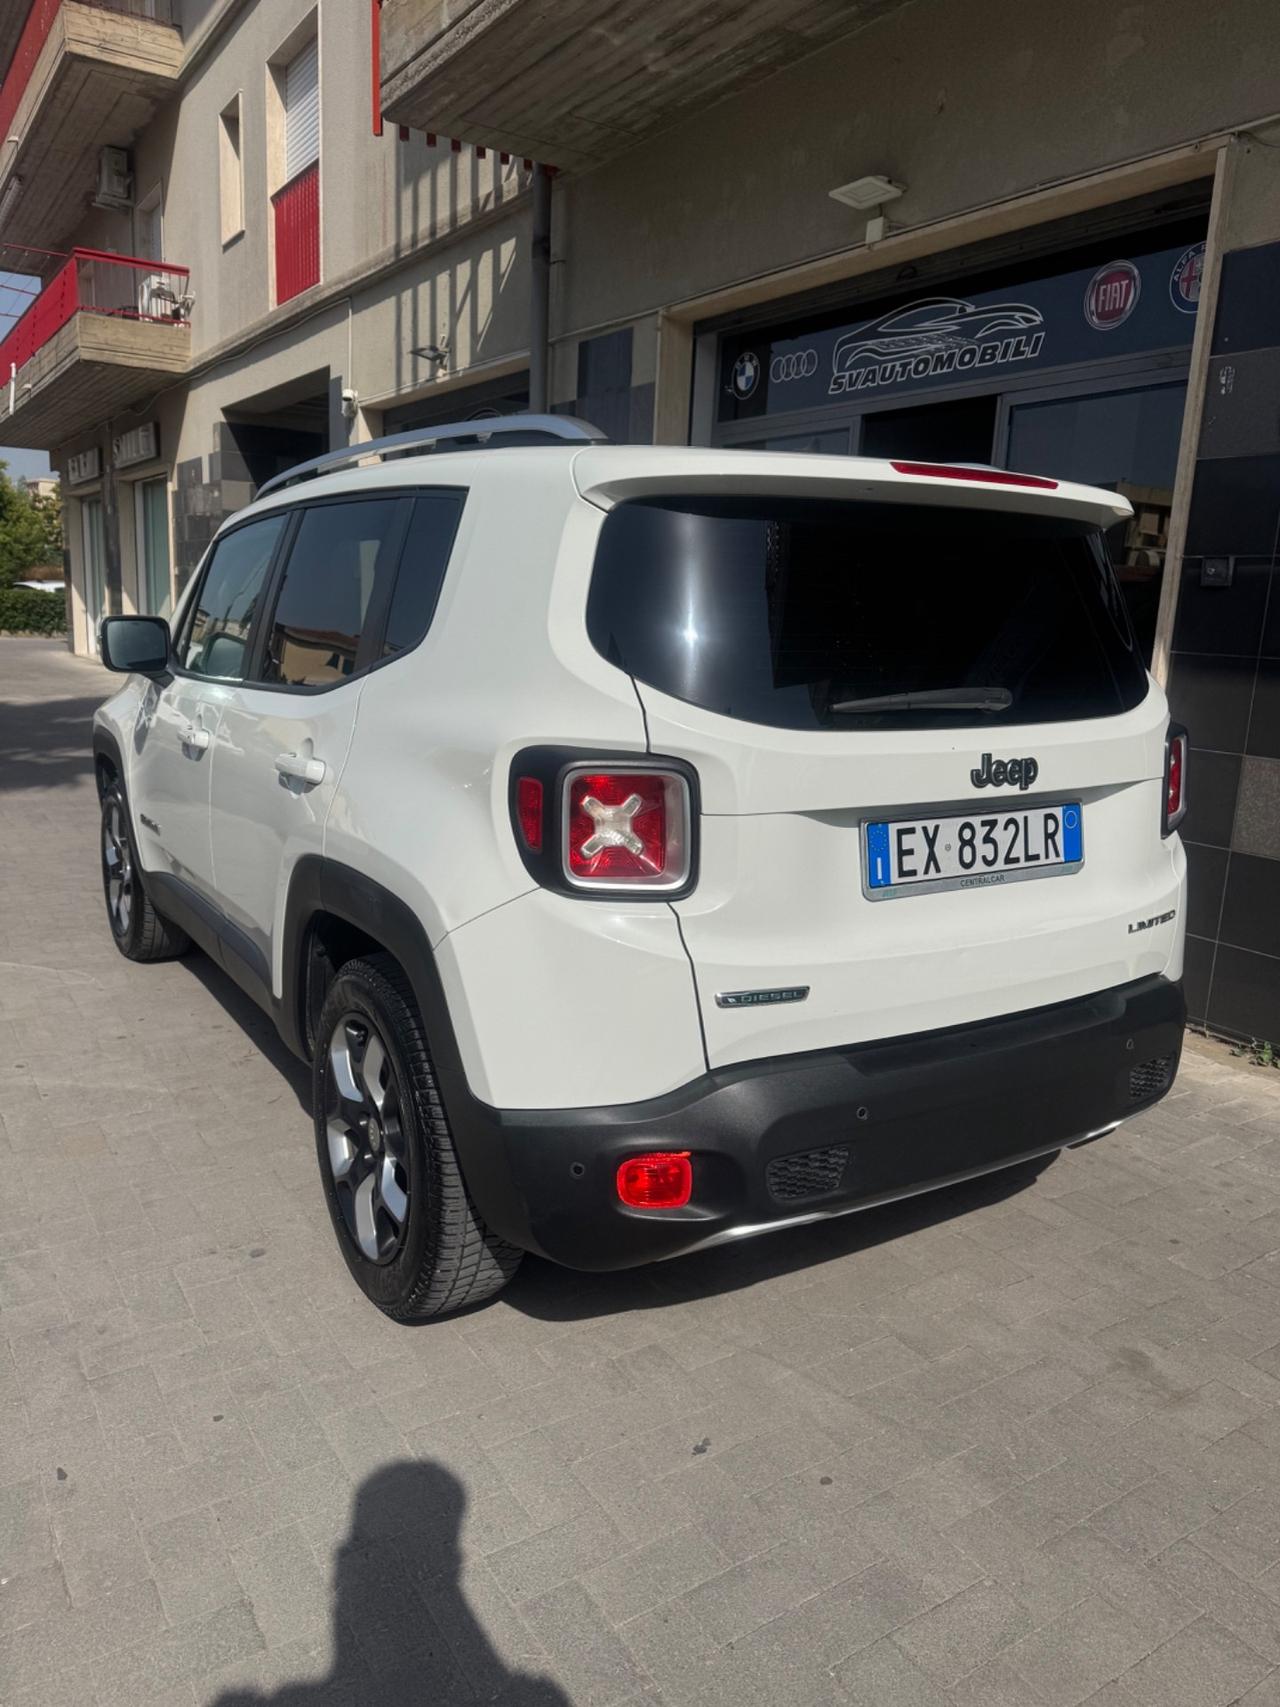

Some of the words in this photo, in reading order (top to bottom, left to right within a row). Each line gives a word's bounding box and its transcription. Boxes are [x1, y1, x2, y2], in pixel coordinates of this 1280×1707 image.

[1173, 250, 1196, 282] ALFA
[1098, 279, 1129, 313] FIAT
[828, 332, 1045, 394] SVAUTOMOBILI
[970, 753, 1038, 791] Jeep
[897, 824, 941, 878] EX
[958, 813, 1060, 870] 832LR
[1127, 909, 1175, 934] LIMITED
[741, 991, 802, 1003] DIESEL
